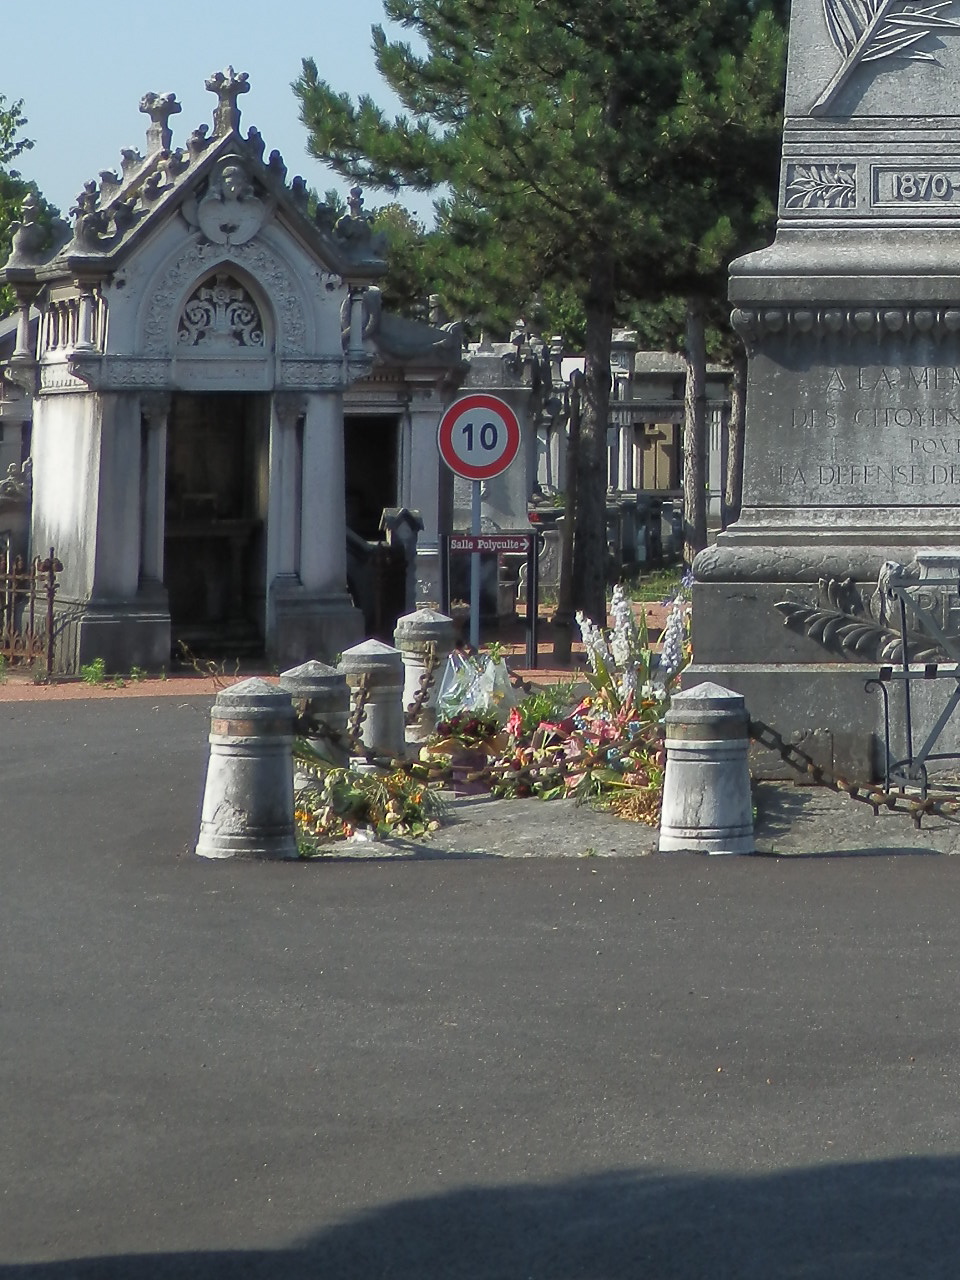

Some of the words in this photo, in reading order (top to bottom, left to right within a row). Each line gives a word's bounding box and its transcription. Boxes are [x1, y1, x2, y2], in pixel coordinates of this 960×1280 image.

[858, 367, 894, 391] LA
[791, 408, 837, 428] DES
[462, 422, 498, 451] 10
[779, 465, 806, 485] LA
[451, 539, 474, 549] Salle
[477, 539, 519, 552] Polyculte
